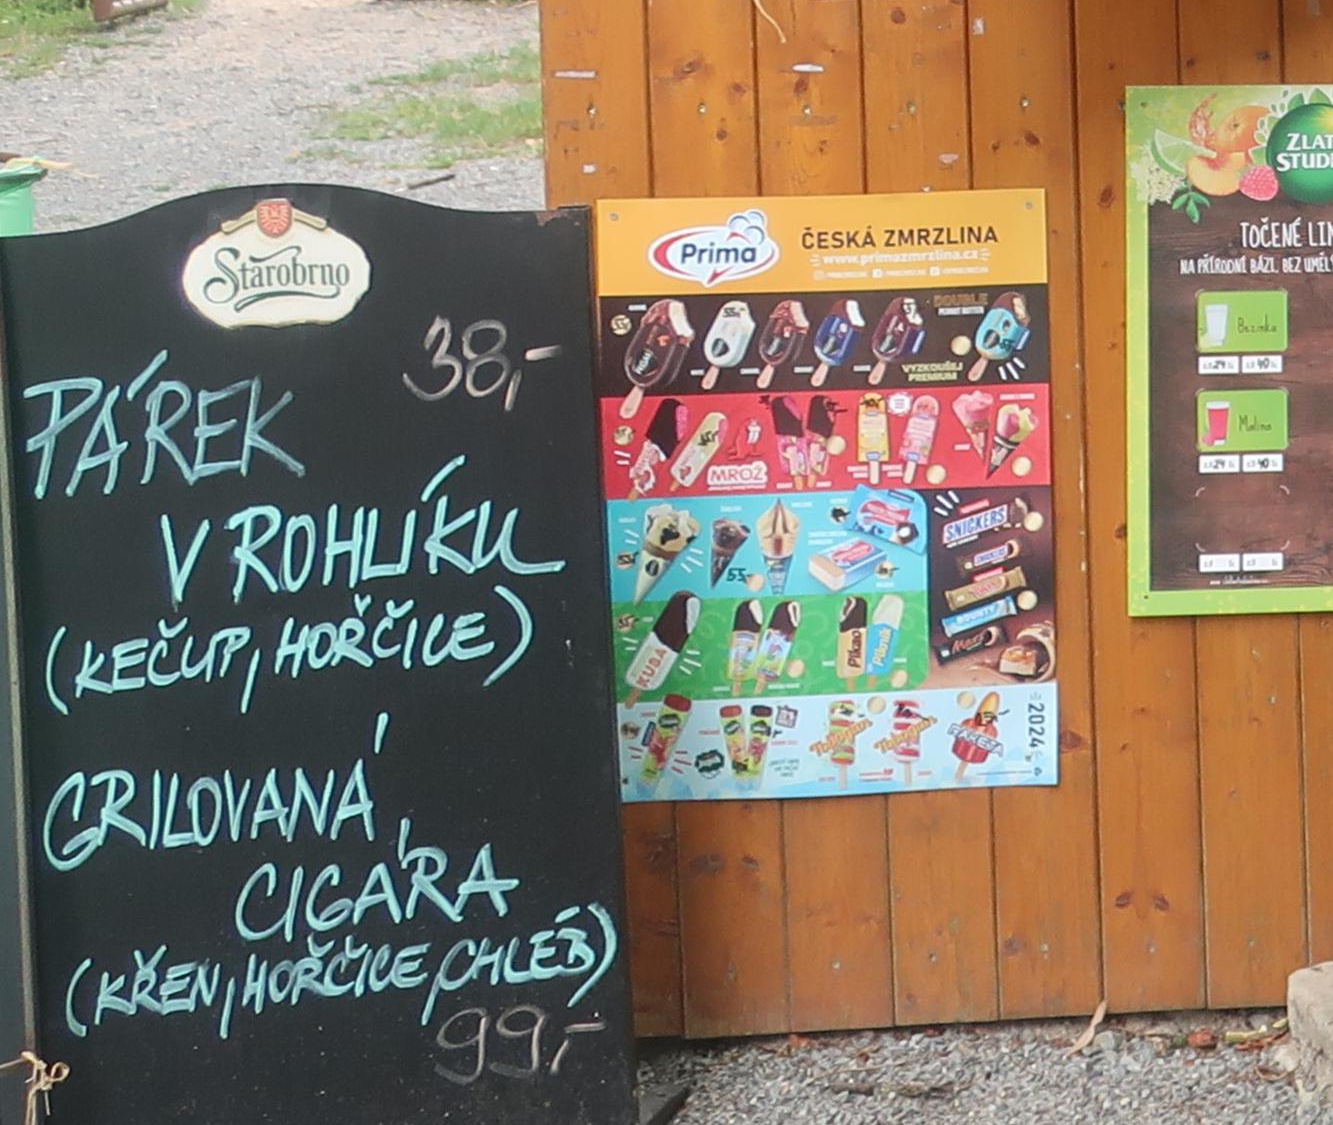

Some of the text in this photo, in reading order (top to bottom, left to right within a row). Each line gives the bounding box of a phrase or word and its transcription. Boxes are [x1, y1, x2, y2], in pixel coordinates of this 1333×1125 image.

[680, 241, 757, 265] Prima
[801, 226, 998, 251] ČESKÁ ZMRZLINA
[1240, 217, 1302, 249] TOČENÉ
[201, 247, 353, 313] Starobrno
[1180, 259, 1195, 274] NA
[1282, 256, 1301, 273] BEZ
[401, 313, 562, 411] 38,-
[23, 349, 306, 501] PÁREK
[710, 465, 767, 483] MROŽ
[161, 454, 565, 611] V ROHLÍKU
[946, 508, 1006, 541] SNICKERS
[1028, 703, 1045, 749] 2024
[42, 712, 391, 872] GRILOVANÁ
[235, 818, 520, 944] CIGÁRA
[435, 1004, 606, 1084] 99,-
